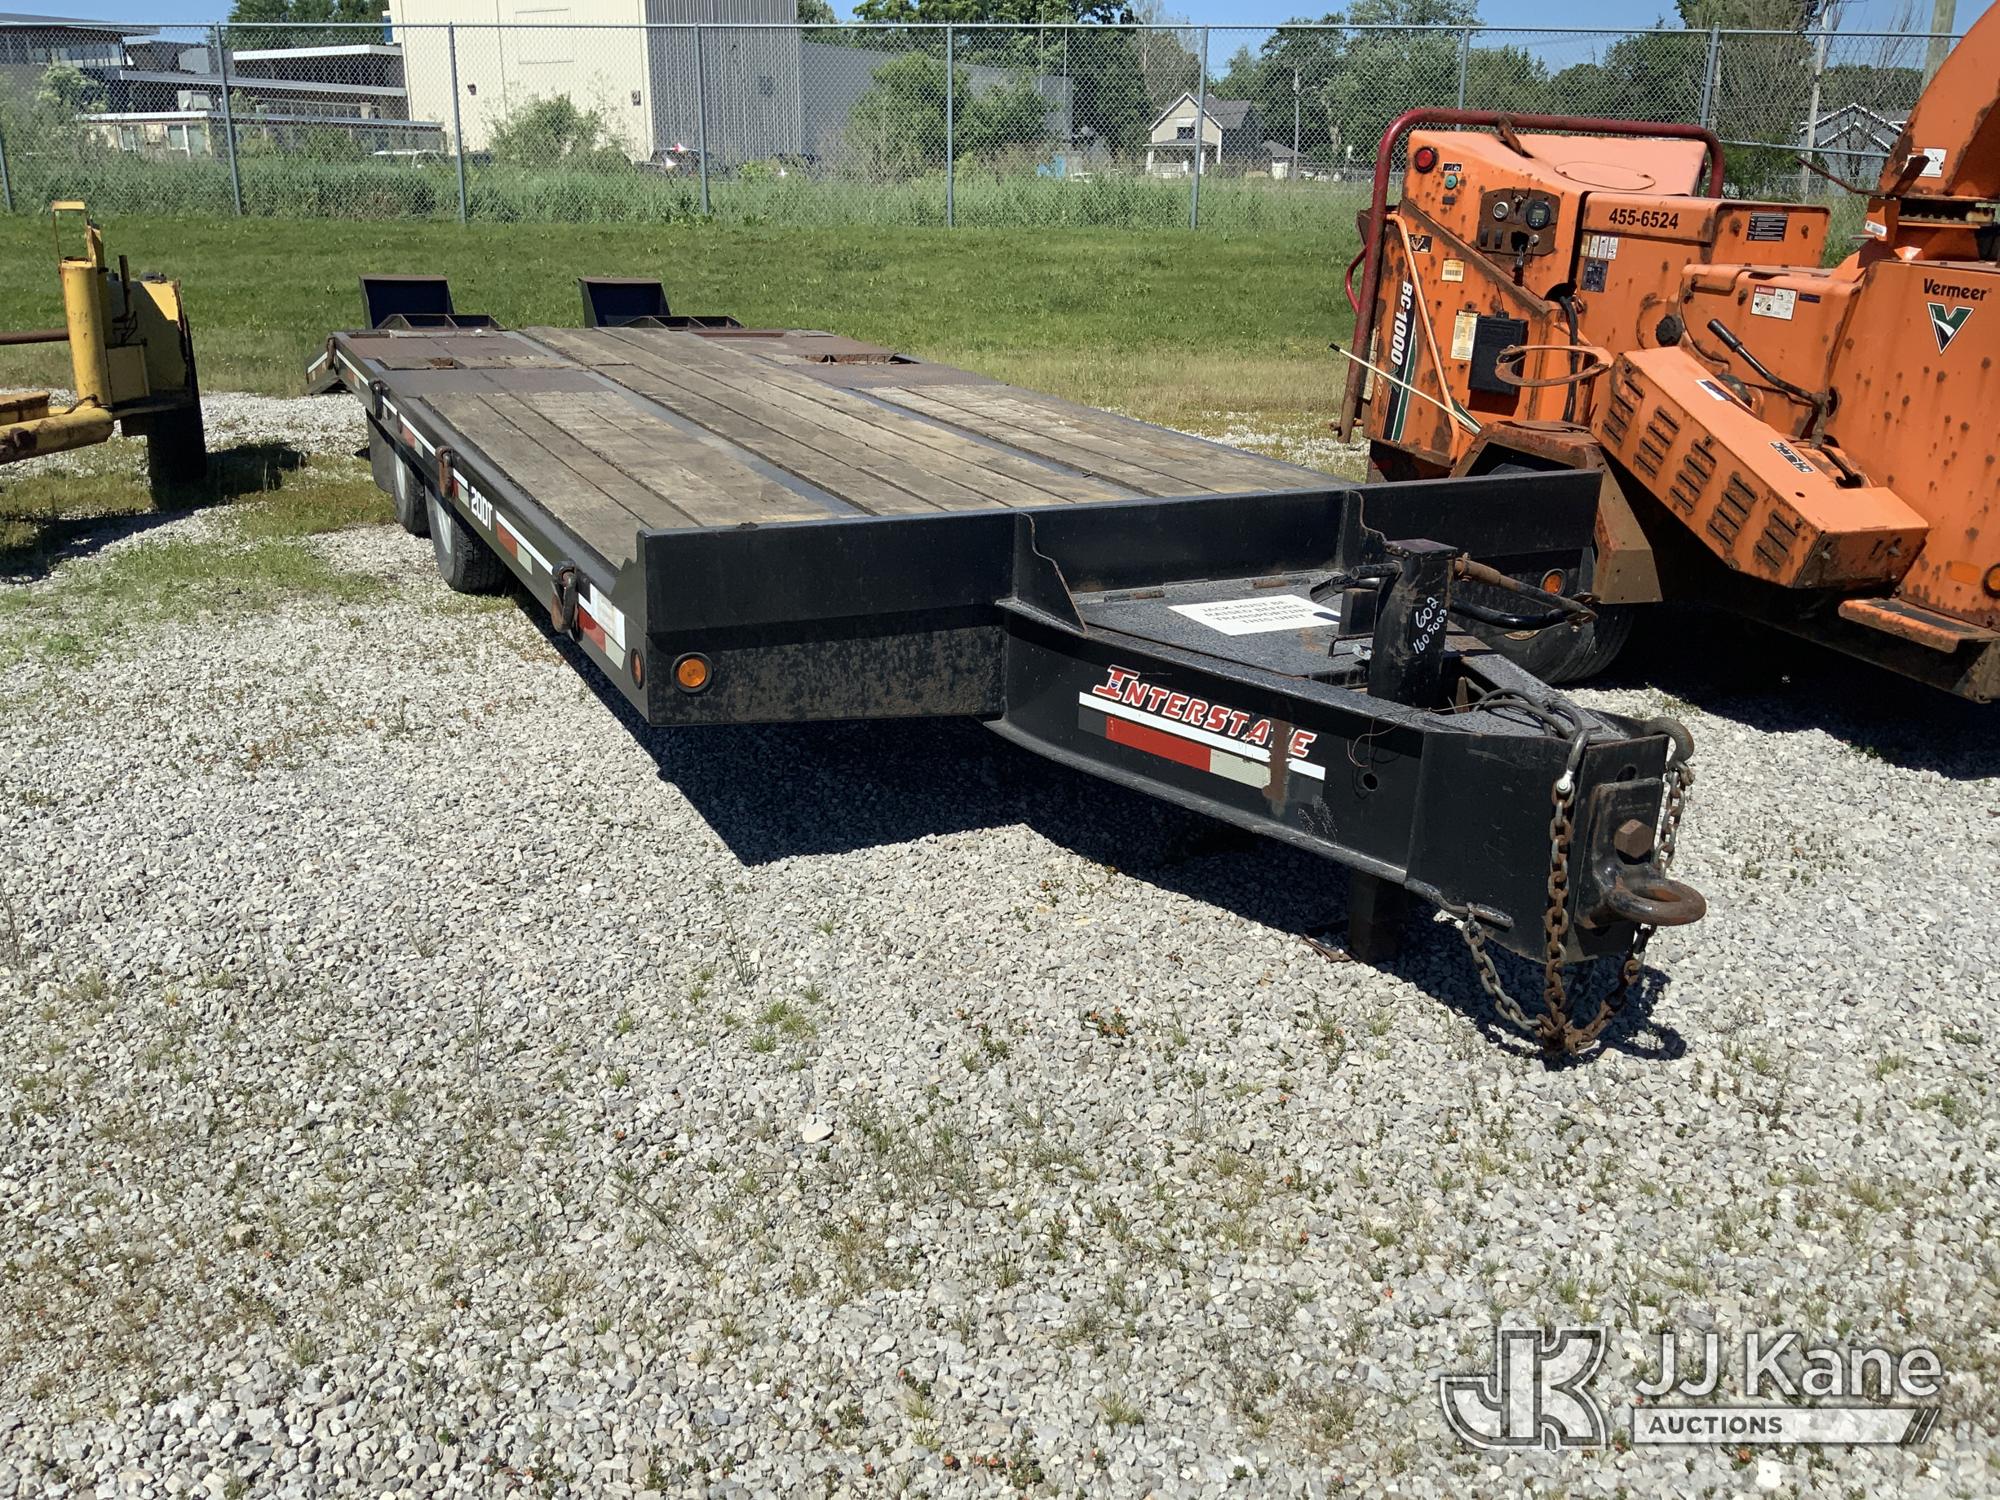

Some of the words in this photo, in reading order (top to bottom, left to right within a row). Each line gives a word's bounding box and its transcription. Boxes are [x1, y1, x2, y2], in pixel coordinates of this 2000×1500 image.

[1608, 207, 1680, 230] 455-6524
[1400, 280, 1414, 310] BC
[1923, 277, 1988, 301] Vermeer
[1390, 311, 1408, 366] 1000
[1414, 596, 1440, 629] 602
[1093, 664, 1317, 758] INTERSTAE
